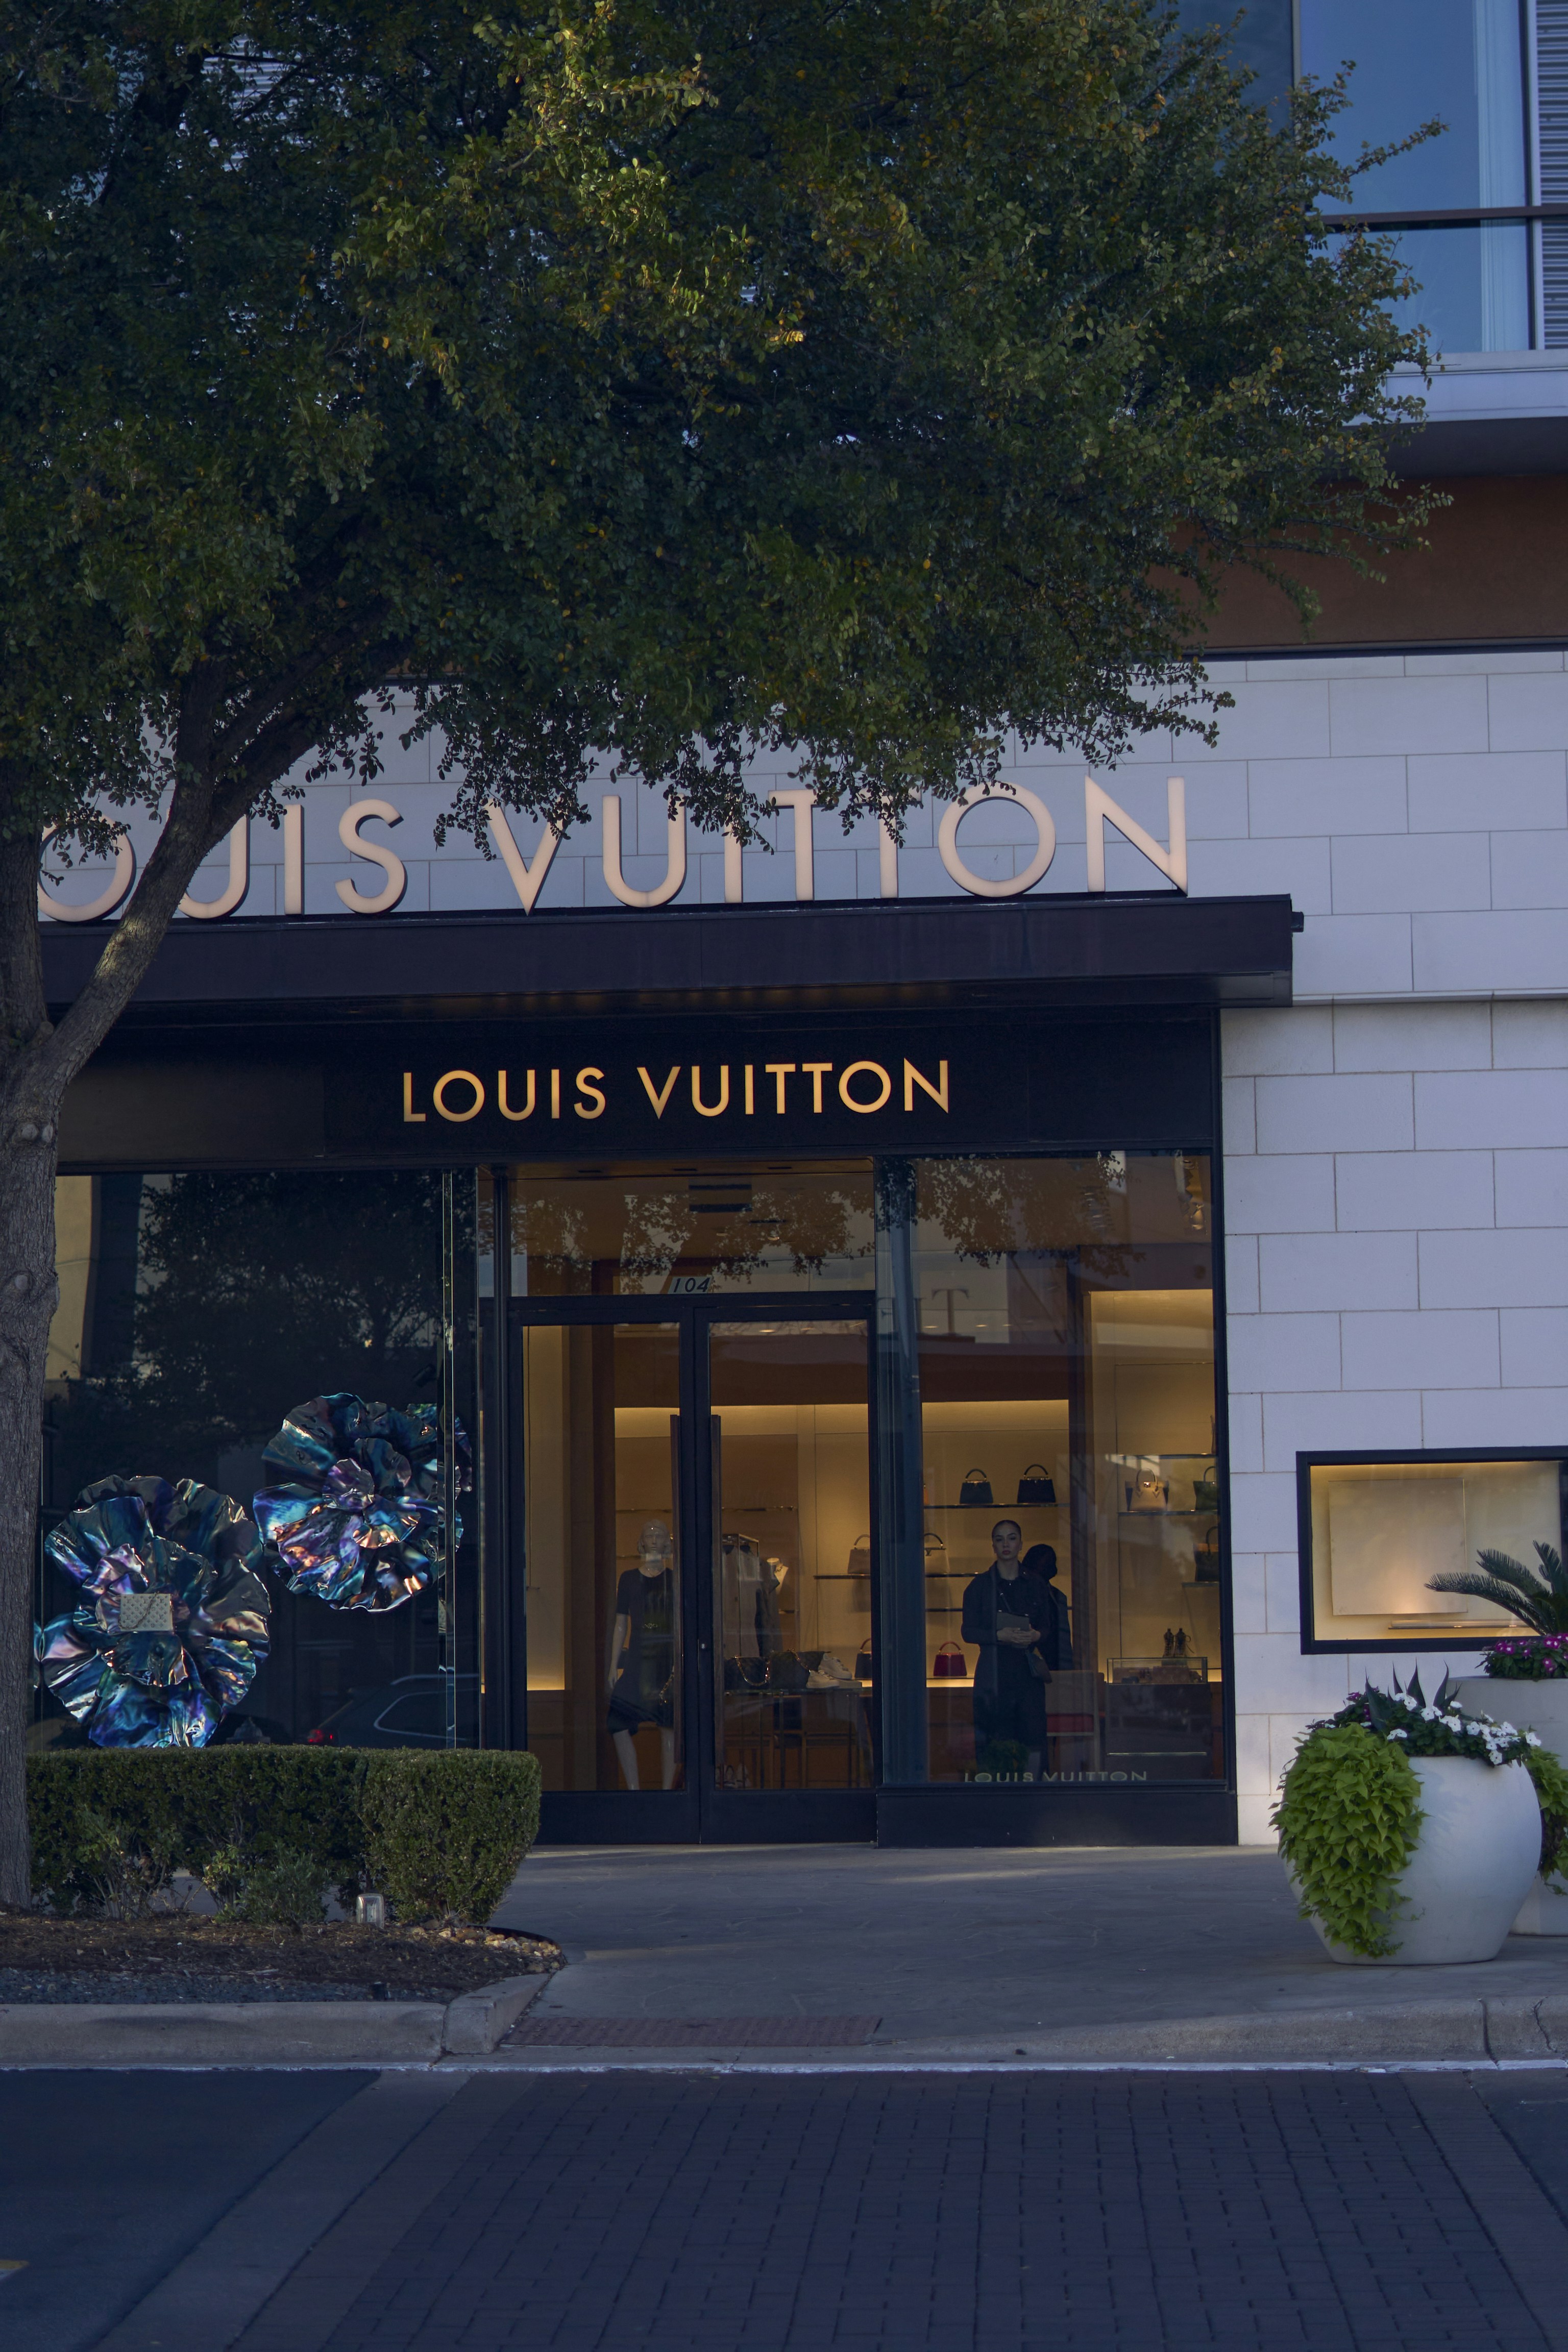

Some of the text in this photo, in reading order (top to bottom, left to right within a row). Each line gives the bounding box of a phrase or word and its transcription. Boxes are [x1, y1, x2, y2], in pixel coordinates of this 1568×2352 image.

[483, 775, 1188, 917] VUITTON
[403, 1058, 948, 1122] LOUIS VUITTON
[673, 1278, 710, 1292] 104
[964, 1771, 1147, 1782] LOUIS VUITTON
